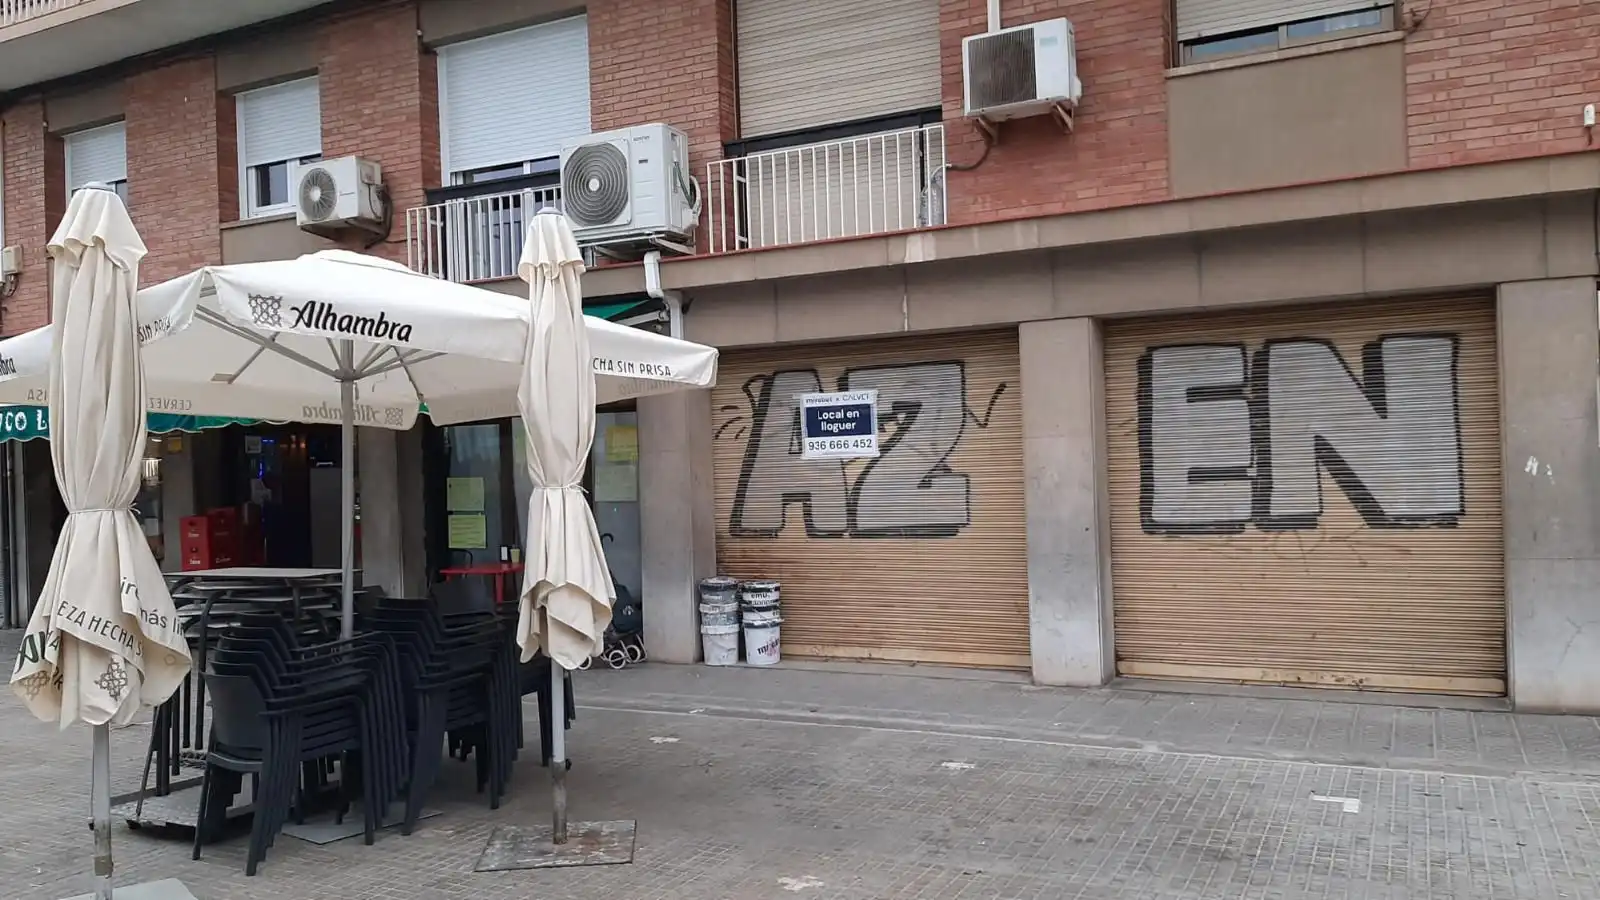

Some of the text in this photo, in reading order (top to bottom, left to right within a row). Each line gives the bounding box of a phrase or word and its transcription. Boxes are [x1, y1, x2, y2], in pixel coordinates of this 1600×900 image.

[290, 300, 413, 342] Alhambra
[592, 357, 672, 377] CHA SIN PRISA
[817, 409, 859, 420] Local en
[821, 421, 856, 432] lloguer
[1137, 333, 1466, 536] EN
[808, 438, 873, 451] 936 666 452
[57, 600, 86, 627] EZA
[88, 616, 134, 650] HECHA
